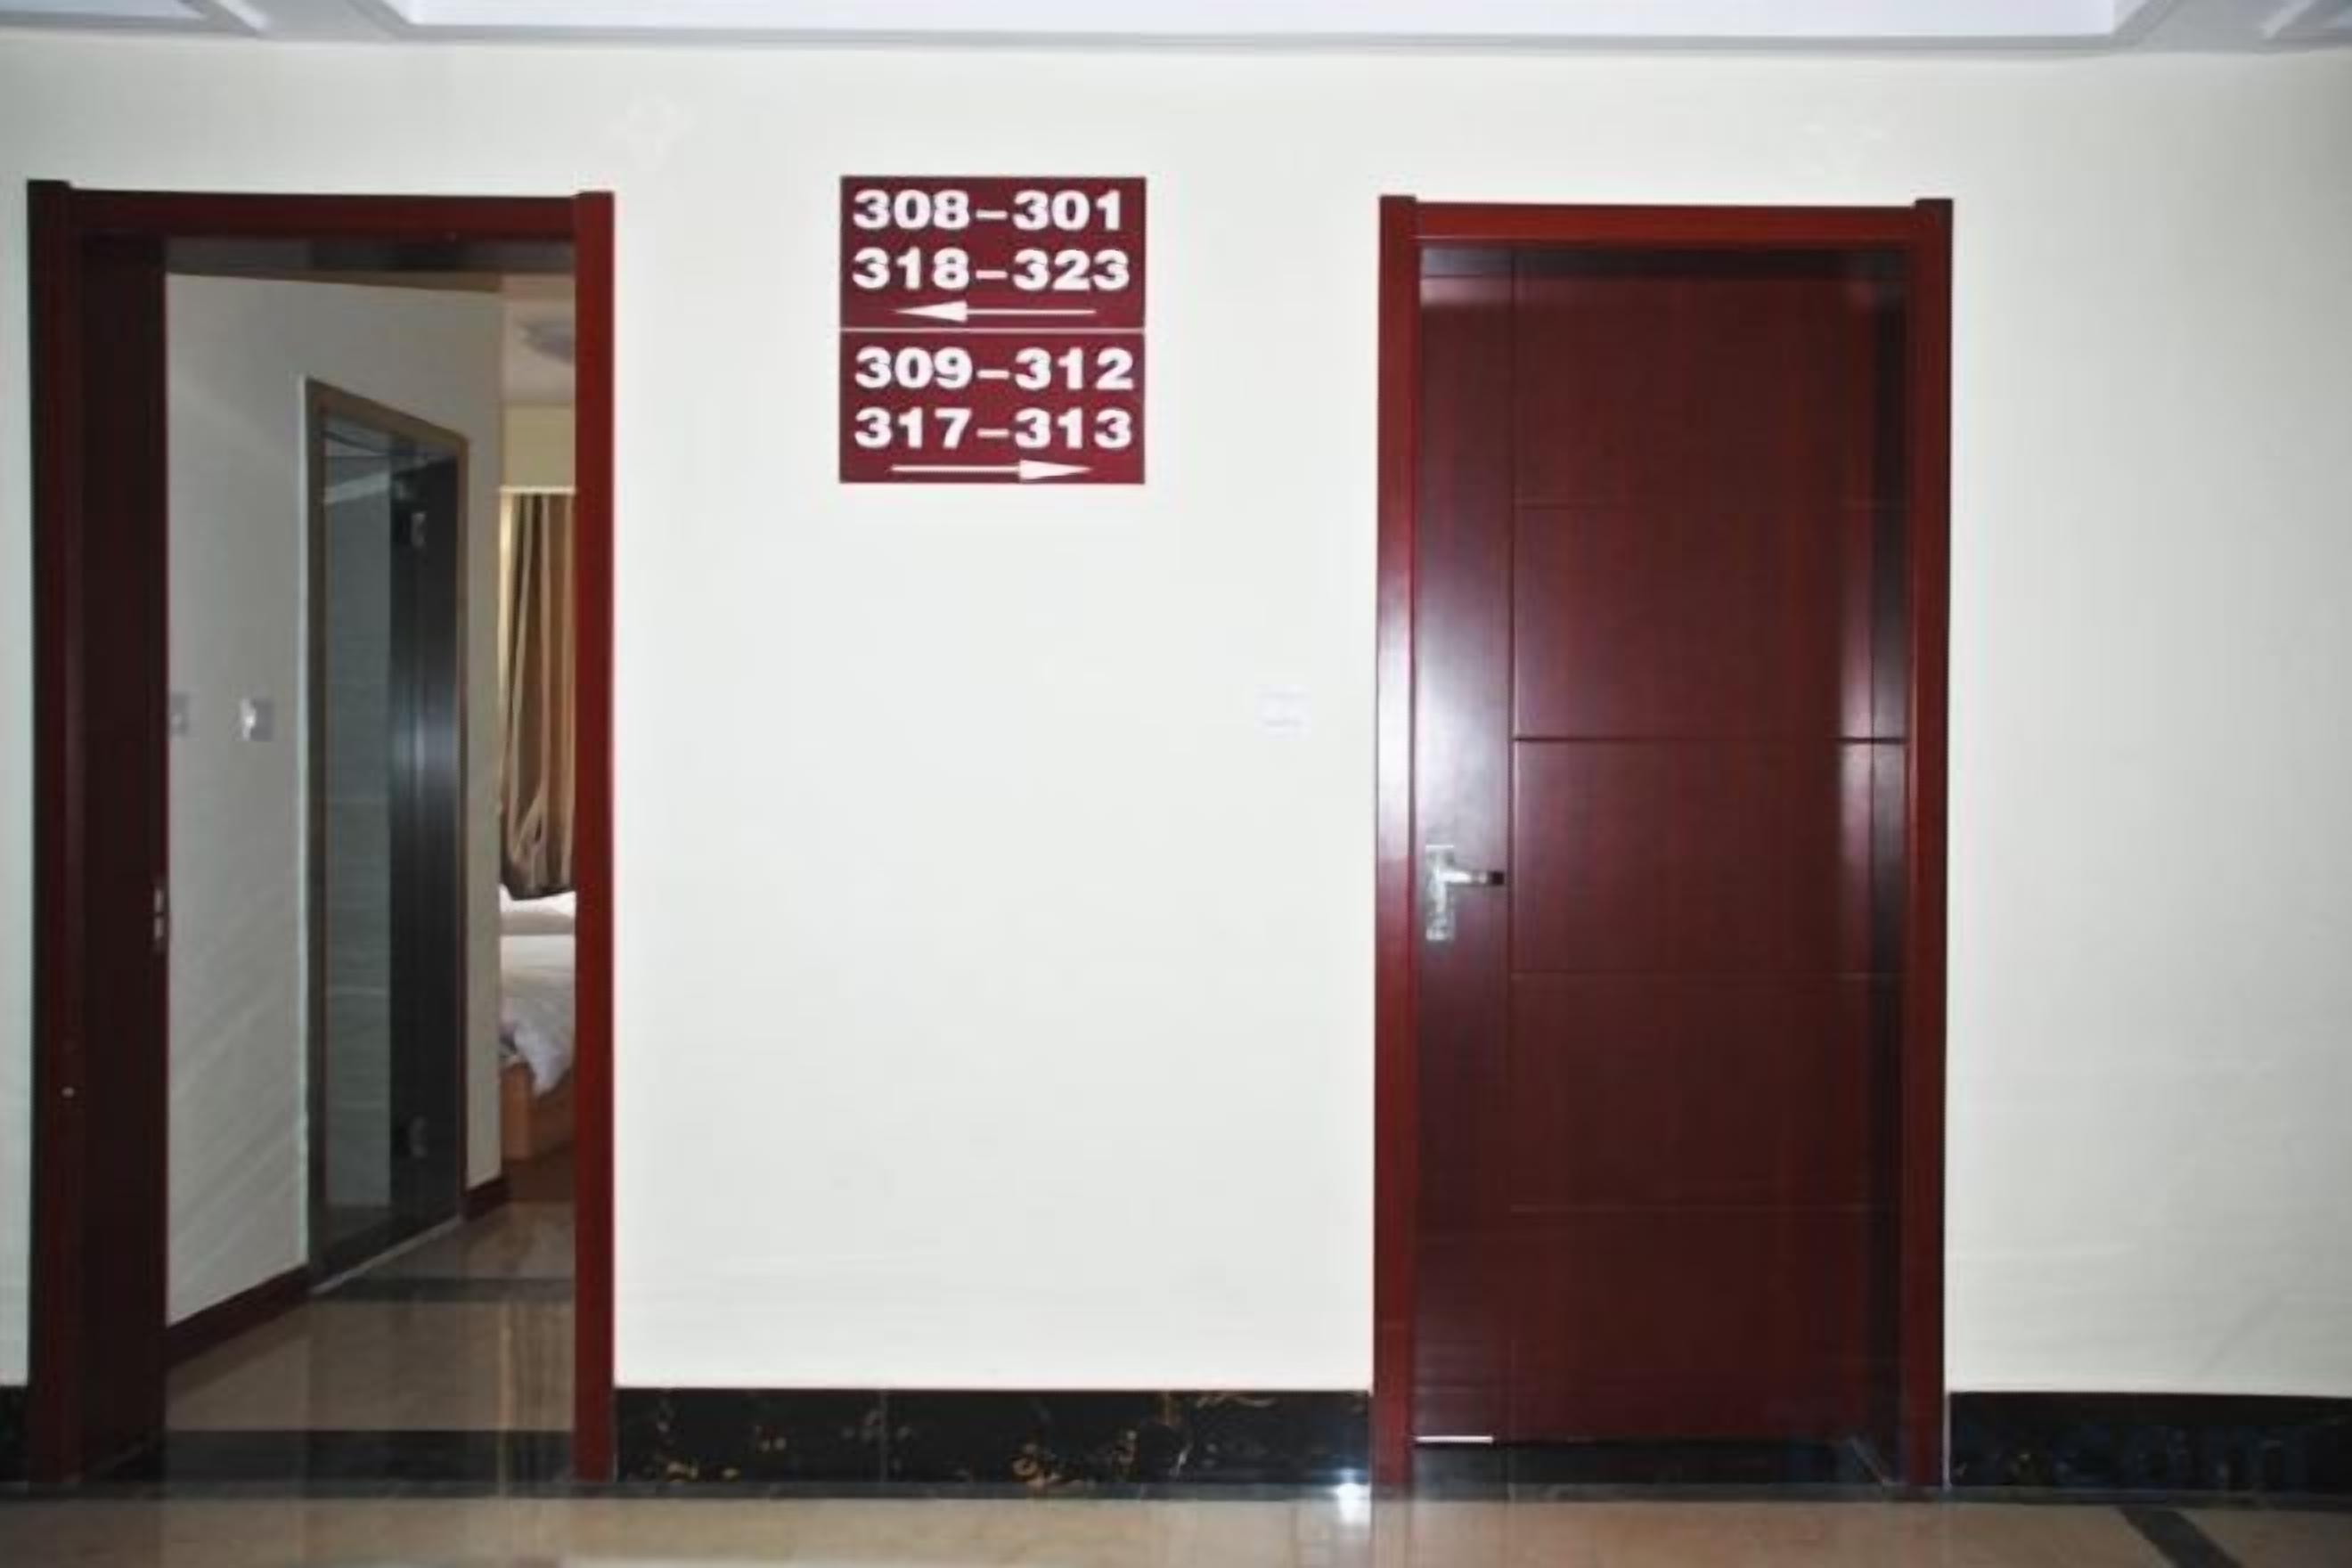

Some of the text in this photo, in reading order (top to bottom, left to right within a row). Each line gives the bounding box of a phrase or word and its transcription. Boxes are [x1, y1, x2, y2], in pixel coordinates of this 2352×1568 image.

[853, 189, 1121, 231] 308-301
[852, 247, 1130, 291] 318-323
[854, 347, 1134, 390] 309-312
[854, 406, 1132, 449] 317-313
